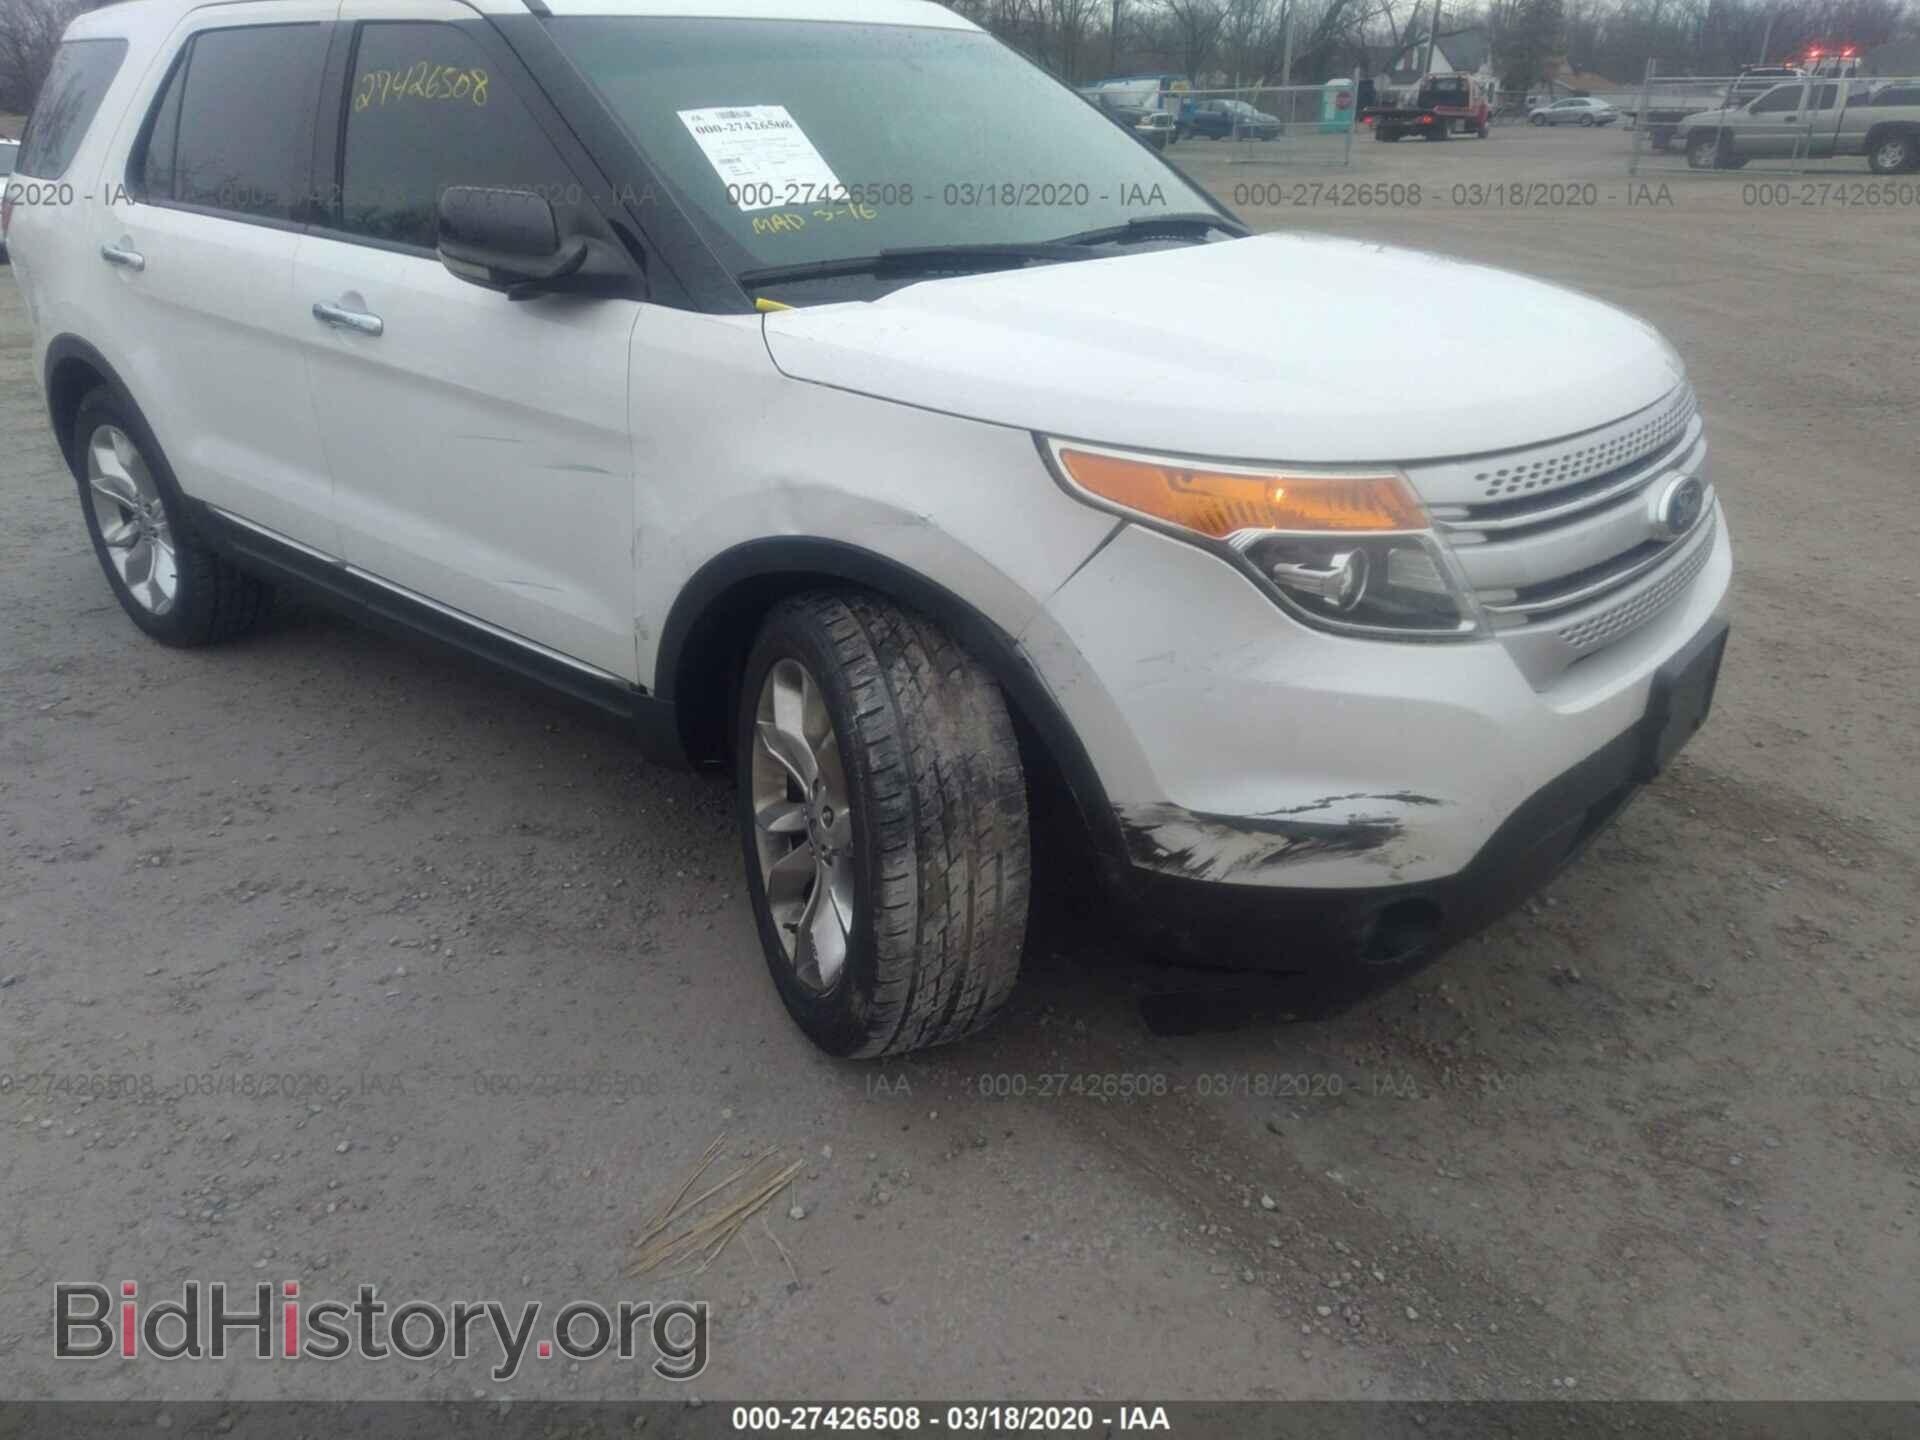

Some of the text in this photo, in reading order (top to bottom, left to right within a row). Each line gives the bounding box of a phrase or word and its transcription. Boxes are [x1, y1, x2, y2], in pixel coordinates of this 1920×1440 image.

[355, 61, 488, 112] 27426508
[694, 119, 793, 135] 000-27426508
[752, 213, 805, 234] MAD
